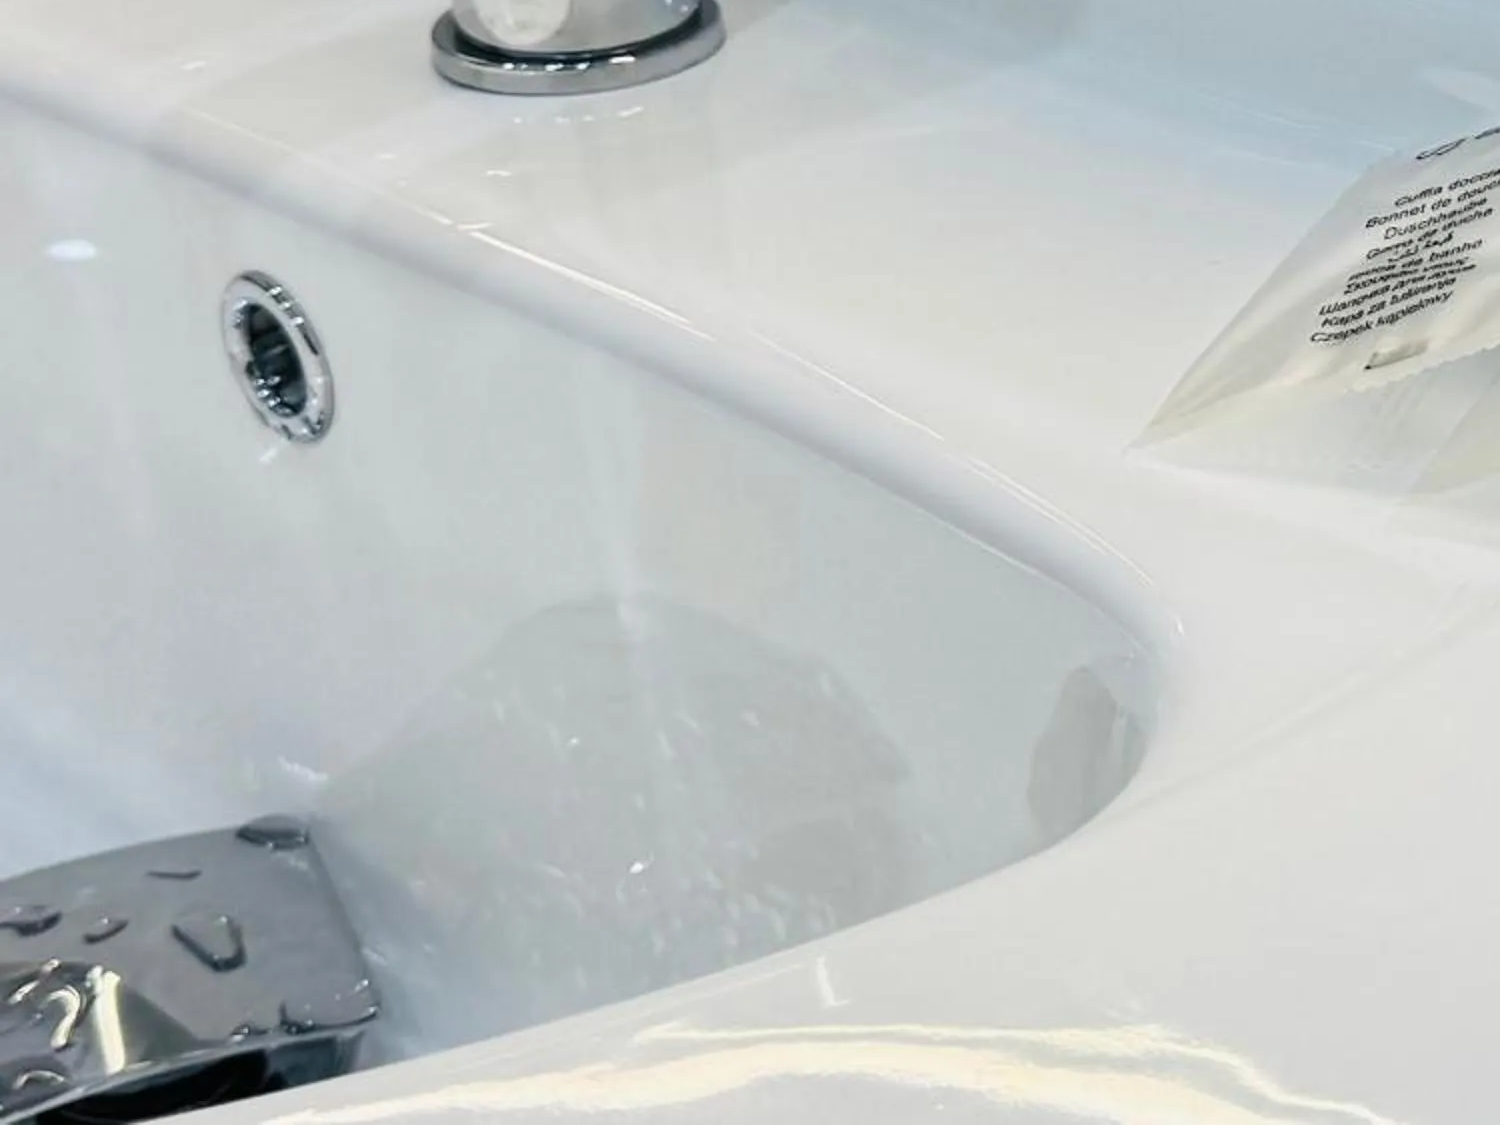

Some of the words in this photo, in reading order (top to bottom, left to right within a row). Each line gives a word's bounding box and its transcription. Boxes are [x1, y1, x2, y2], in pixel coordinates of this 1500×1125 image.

[1365, 204, 1426, 228] Bonnet
[1431, 197, 1452, 210] de
[1384, 197, 1488, 238] Duschhaube
[1310, 321, 1373, 343] Czepek
